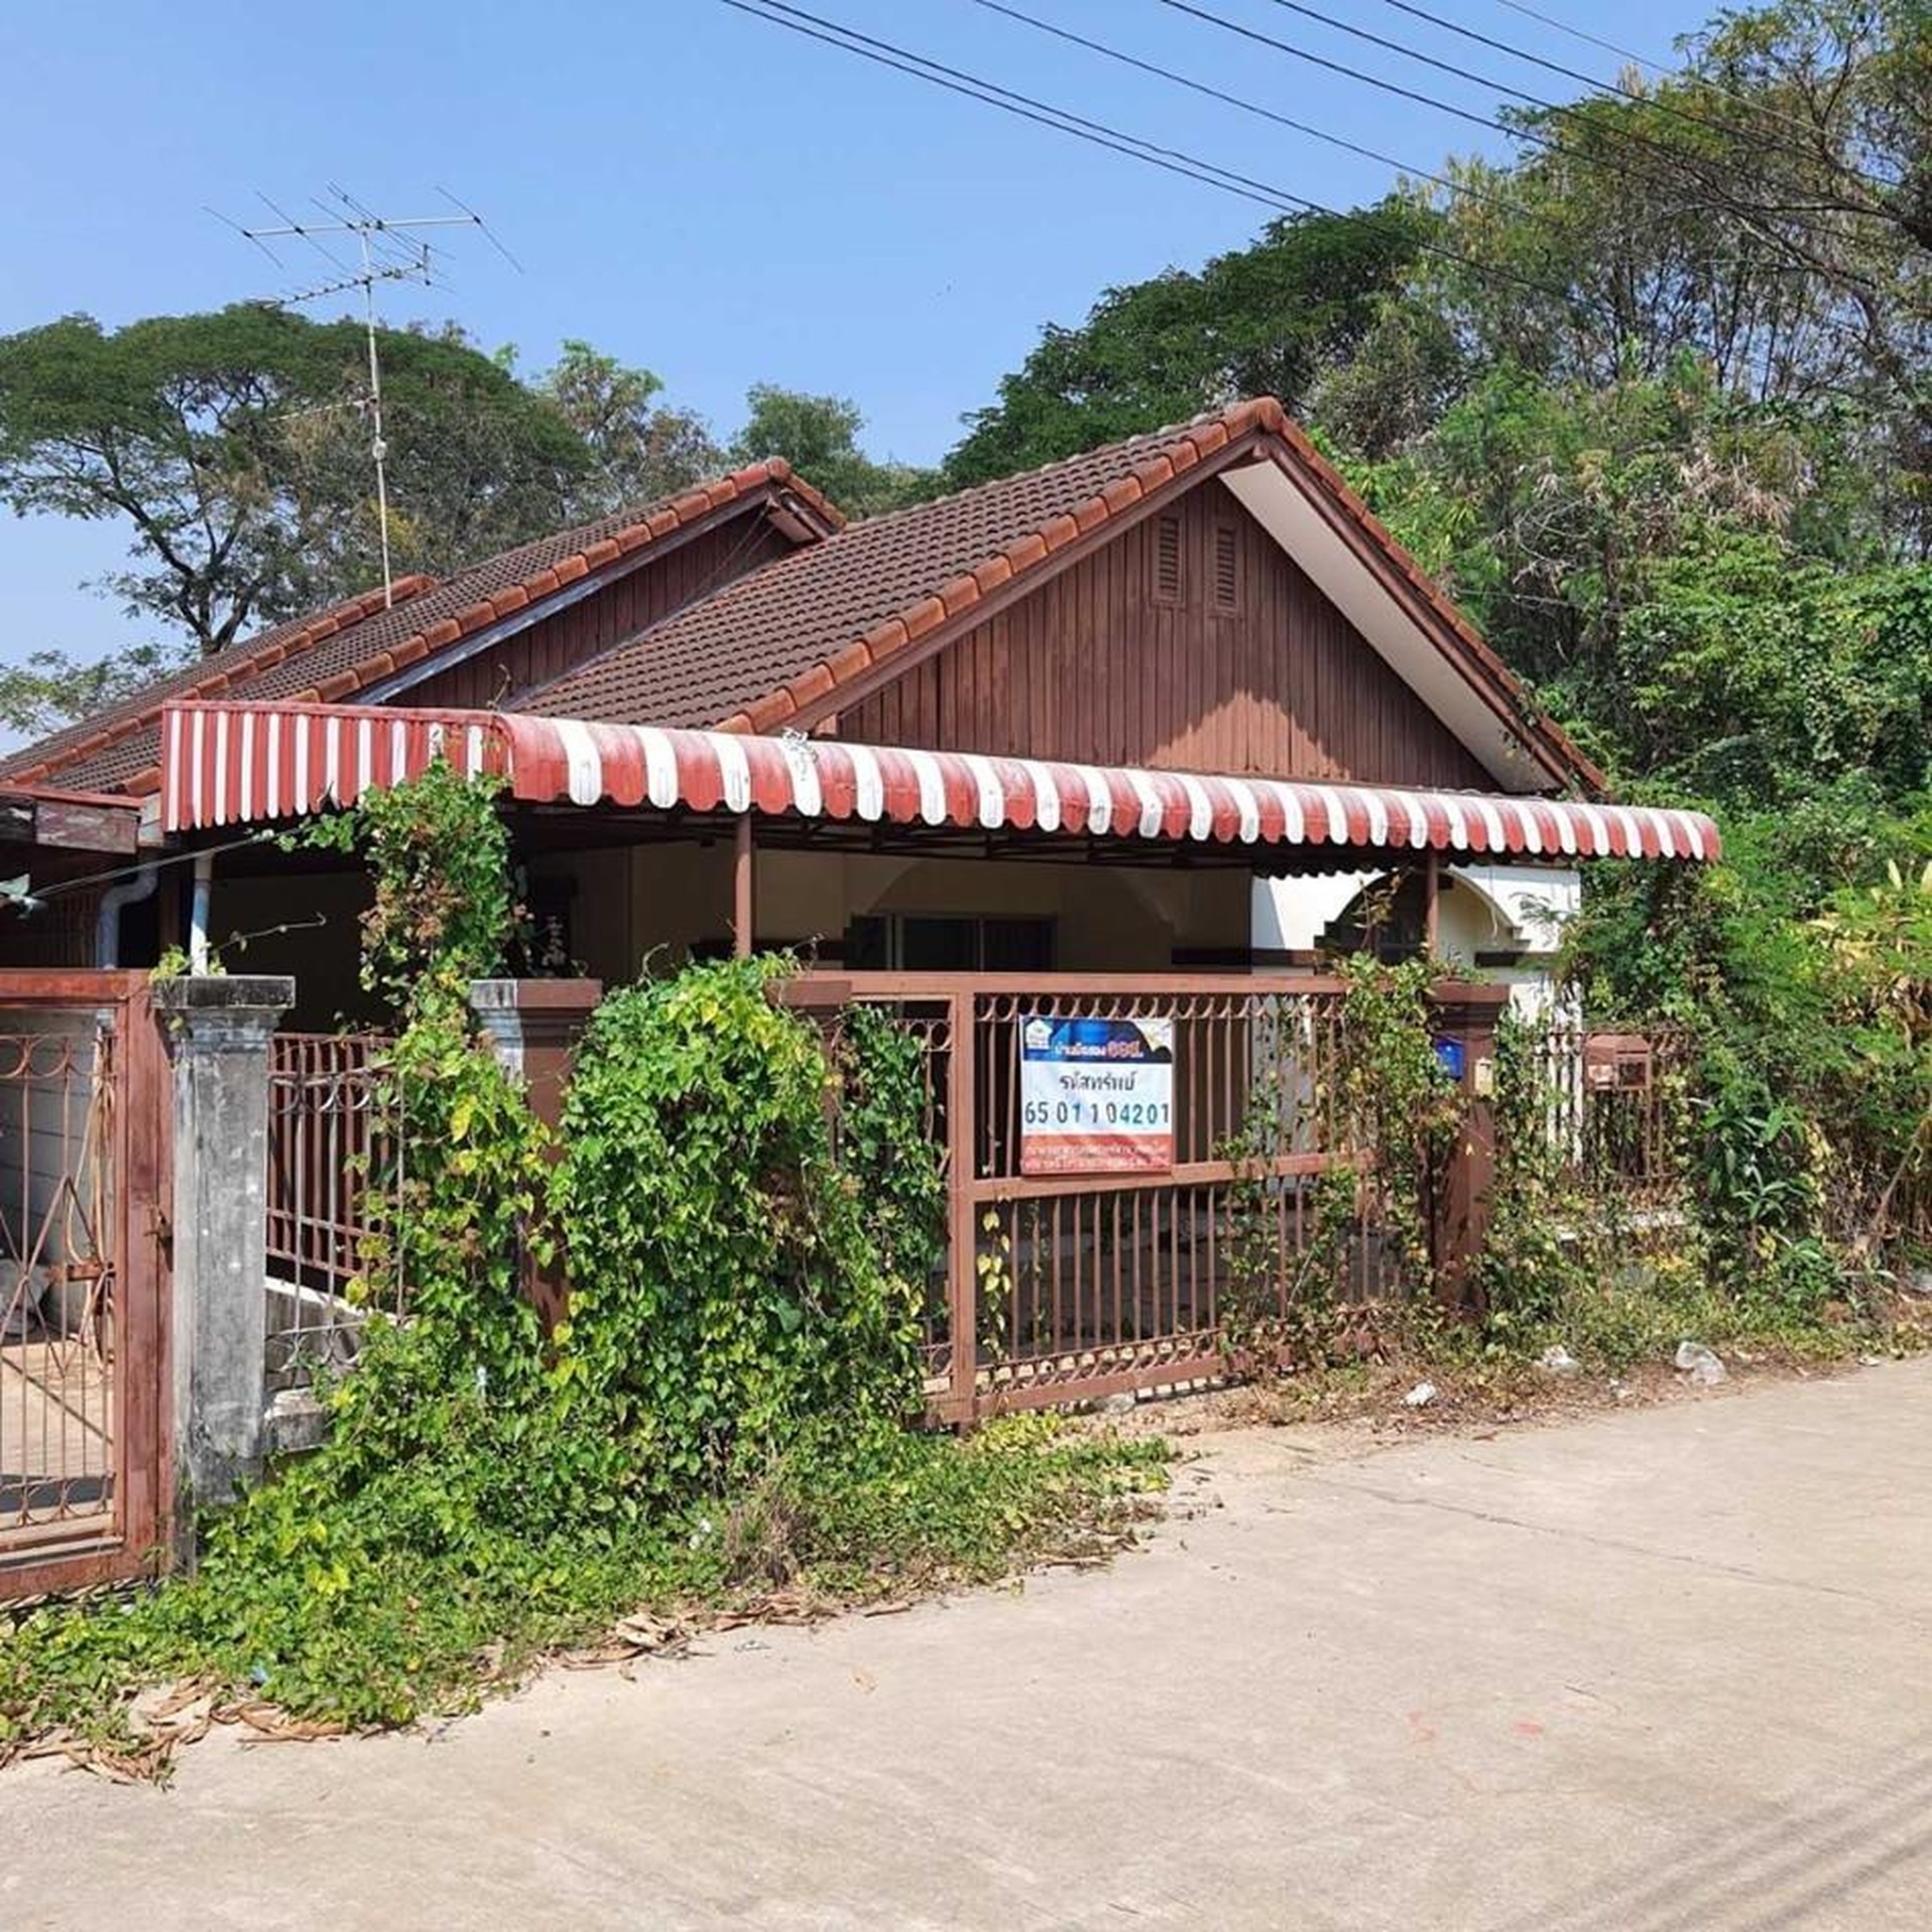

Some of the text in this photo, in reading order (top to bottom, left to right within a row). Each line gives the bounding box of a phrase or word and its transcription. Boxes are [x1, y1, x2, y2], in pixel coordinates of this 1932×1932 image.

[1059, 1071, 1138, 1091] รหัสทรัพย์
[1024, 1101, 1170, 1124] 65 01 1 04201
